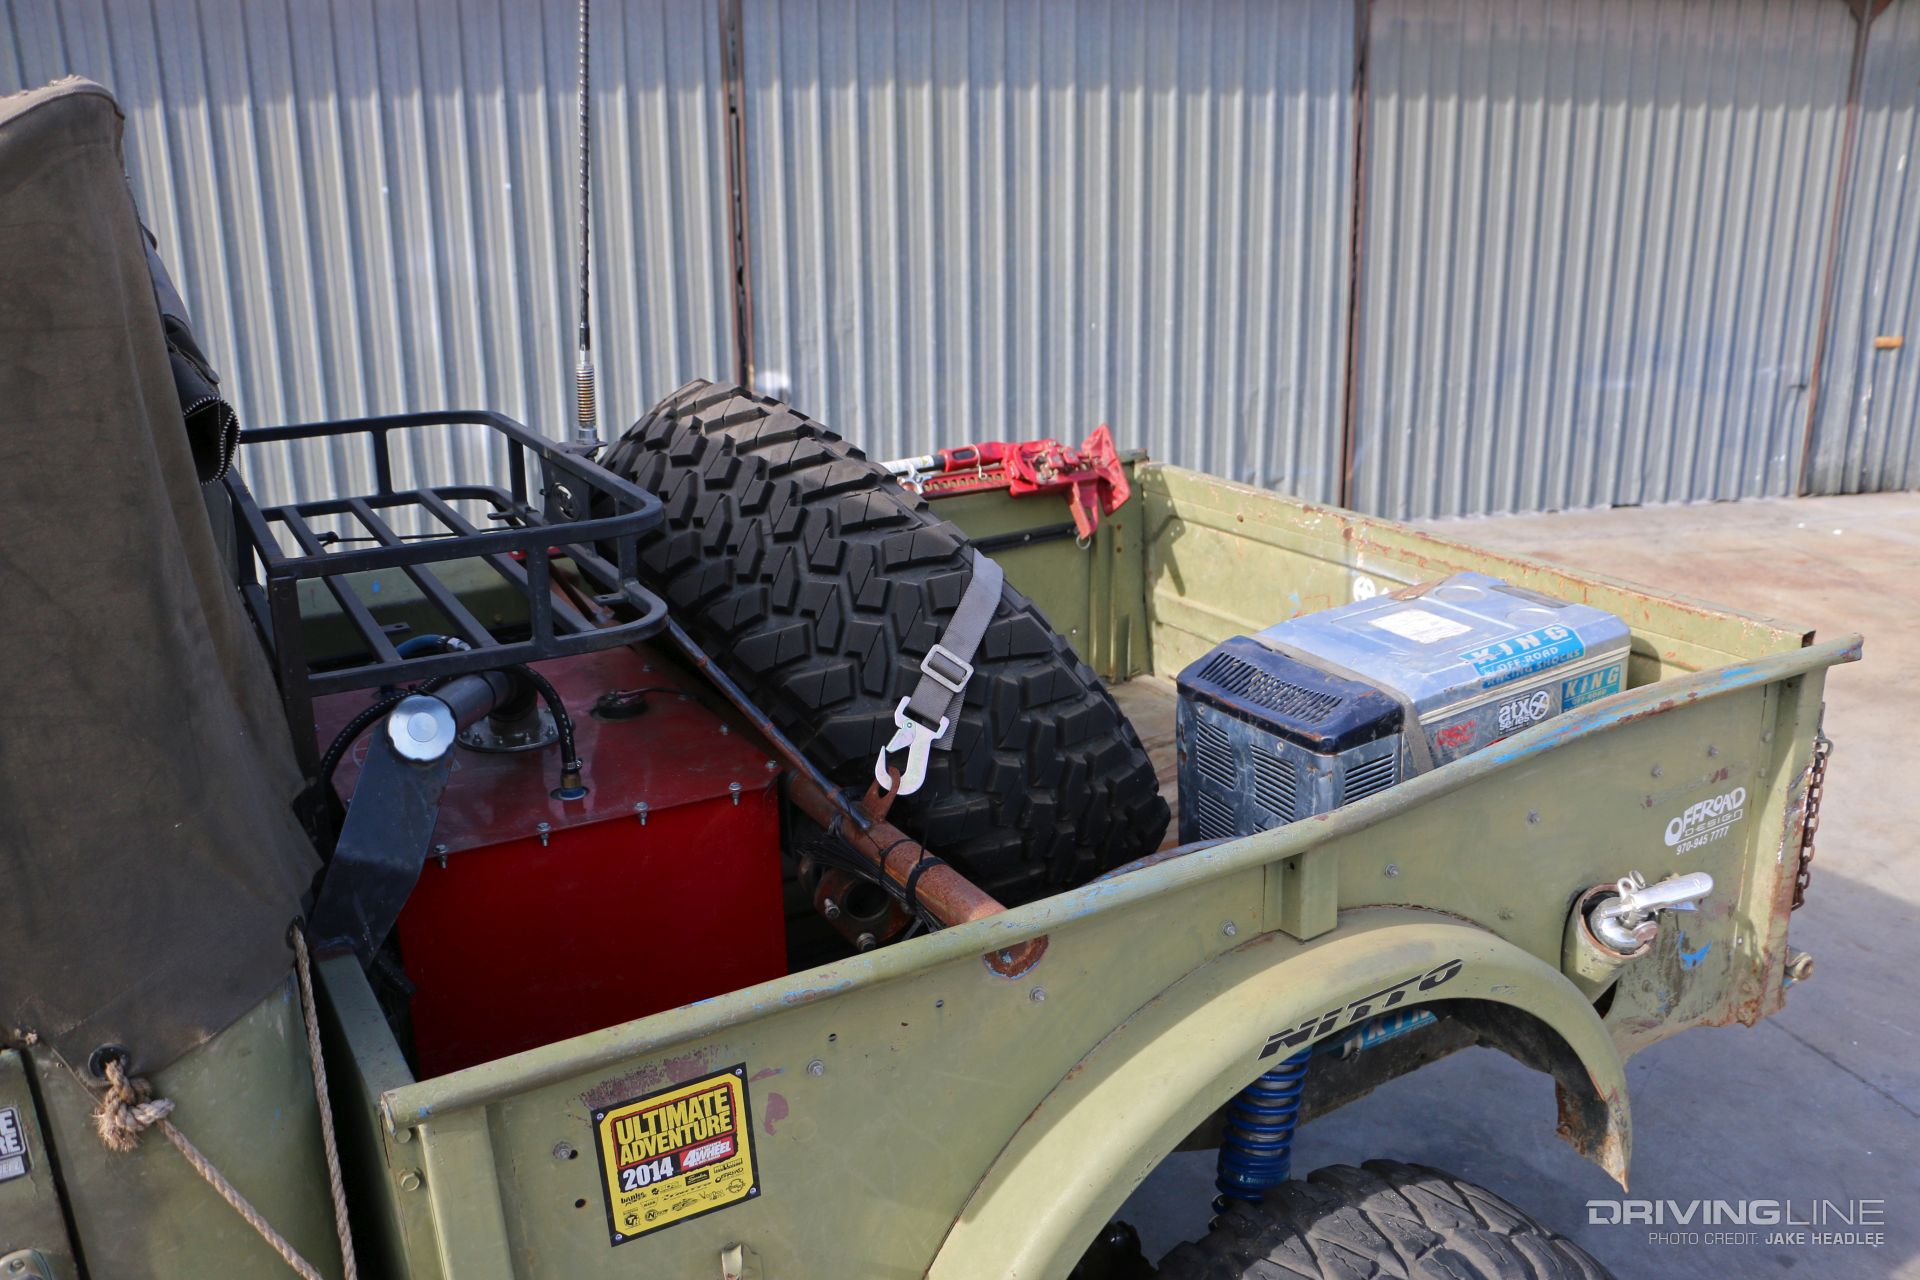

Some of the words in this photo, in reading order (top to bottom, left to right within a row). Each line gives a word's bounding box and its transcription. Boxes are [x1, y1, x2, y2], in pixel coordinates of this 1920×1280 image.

[1471, 626, 1569, 665] KING
[1498, 646, 1559, 672] OFF-ROAD
[1565, 666, 1621, 699] KING
[1498, 697, 1531, 725] atx
[1498, 716, 1530, 731] series
[1664, 786, 1746, 847] OFFROAD
[1257, 958, 1463, 1061] NITTO
[615, 1086, 730, 1146] ULTIMATE
[620, 1110, 732, 1167] ADVENTURE
[622, 1156, 674, 1192] 2014
